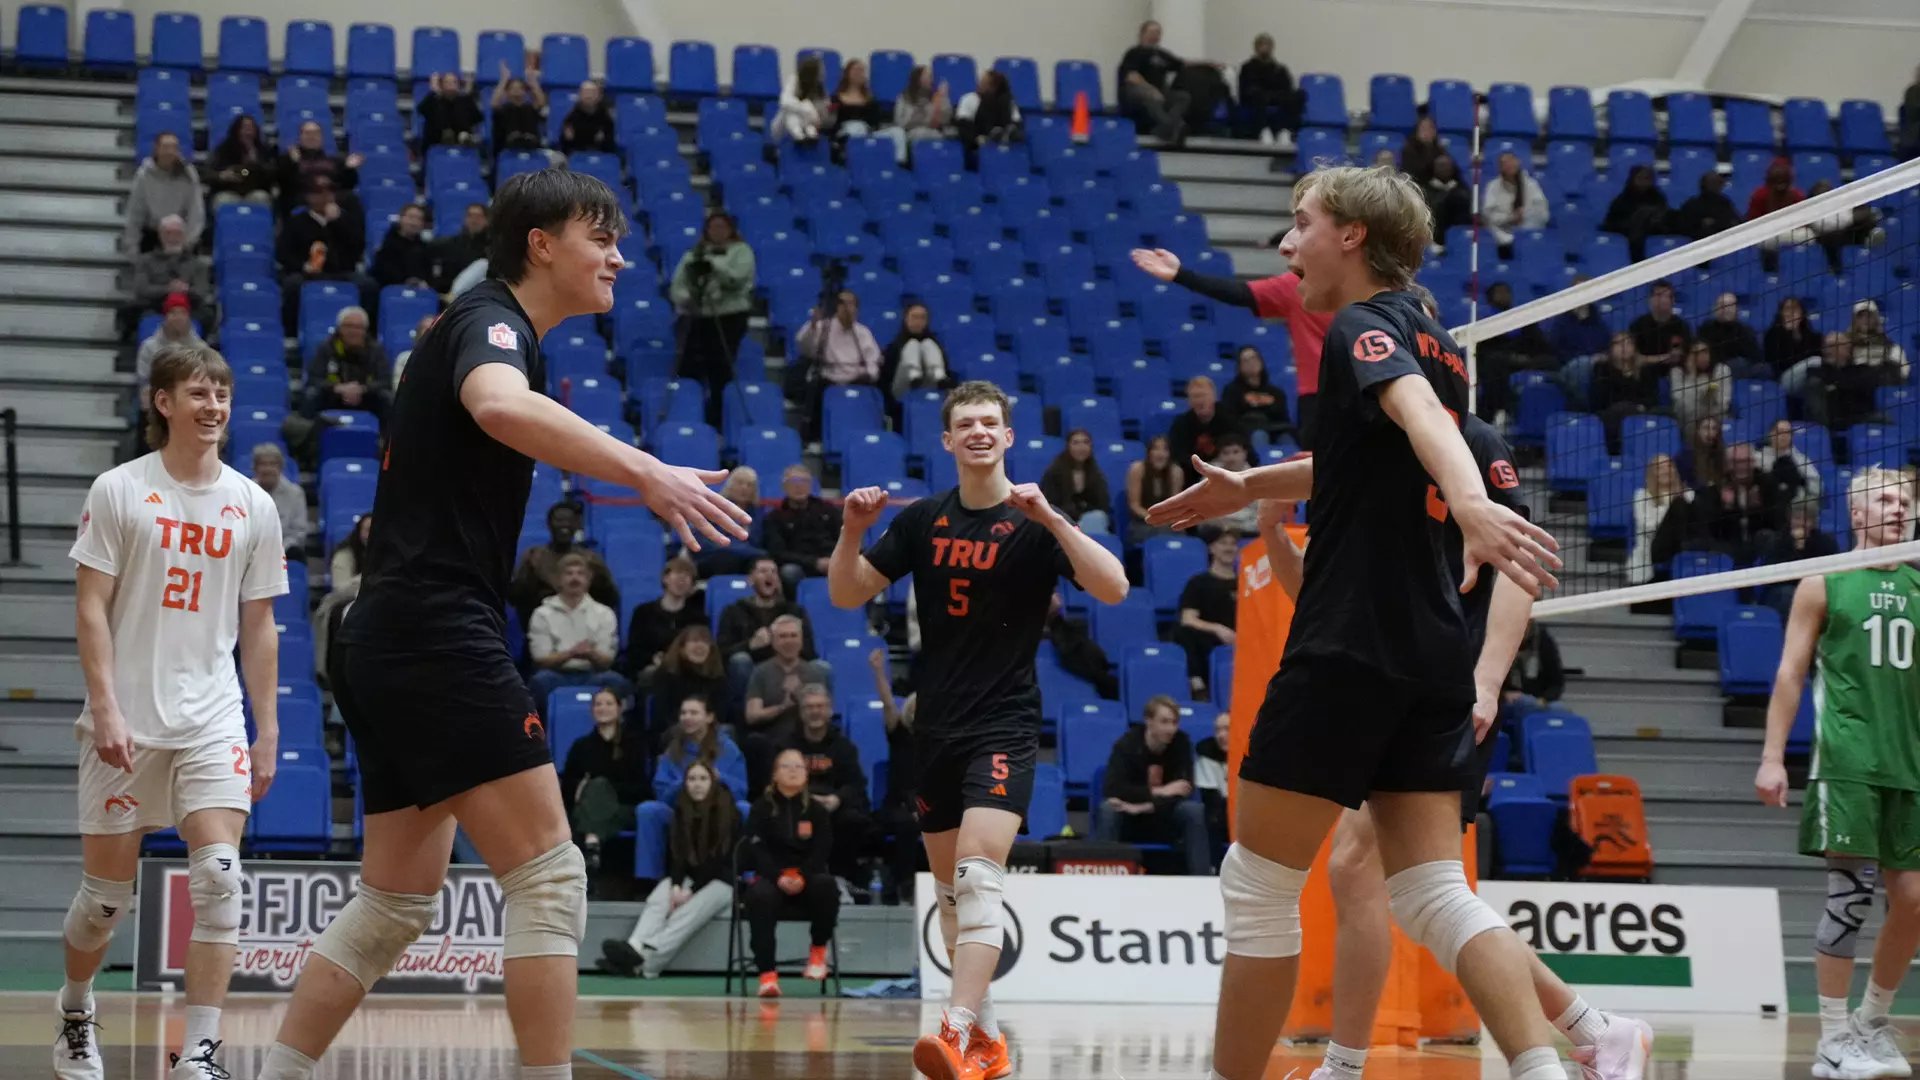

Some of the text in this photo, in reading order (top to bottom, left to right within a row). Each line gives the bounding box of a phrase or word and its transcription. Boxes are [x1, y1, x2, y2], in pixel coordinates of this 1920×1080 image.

[1360, 334, 1389, 358] 15
[1494, 464, 1515, 485] 15
[156, 516, 233, 559] TRU
[931, 537, 999, 570] TRU
[162, 566, 203, 612] 21
[947, 578, 970, 616] 5
[1870, 592, 1907, 612] UFV
[1863, 614, 1915, 669] 10
[992, 753, 1009, 780] 5
[1048, 915, 1224, 965] Stant
[1508, 900, 1686, 955] acres
[233, 935, 504, 986] veryt amloops.
